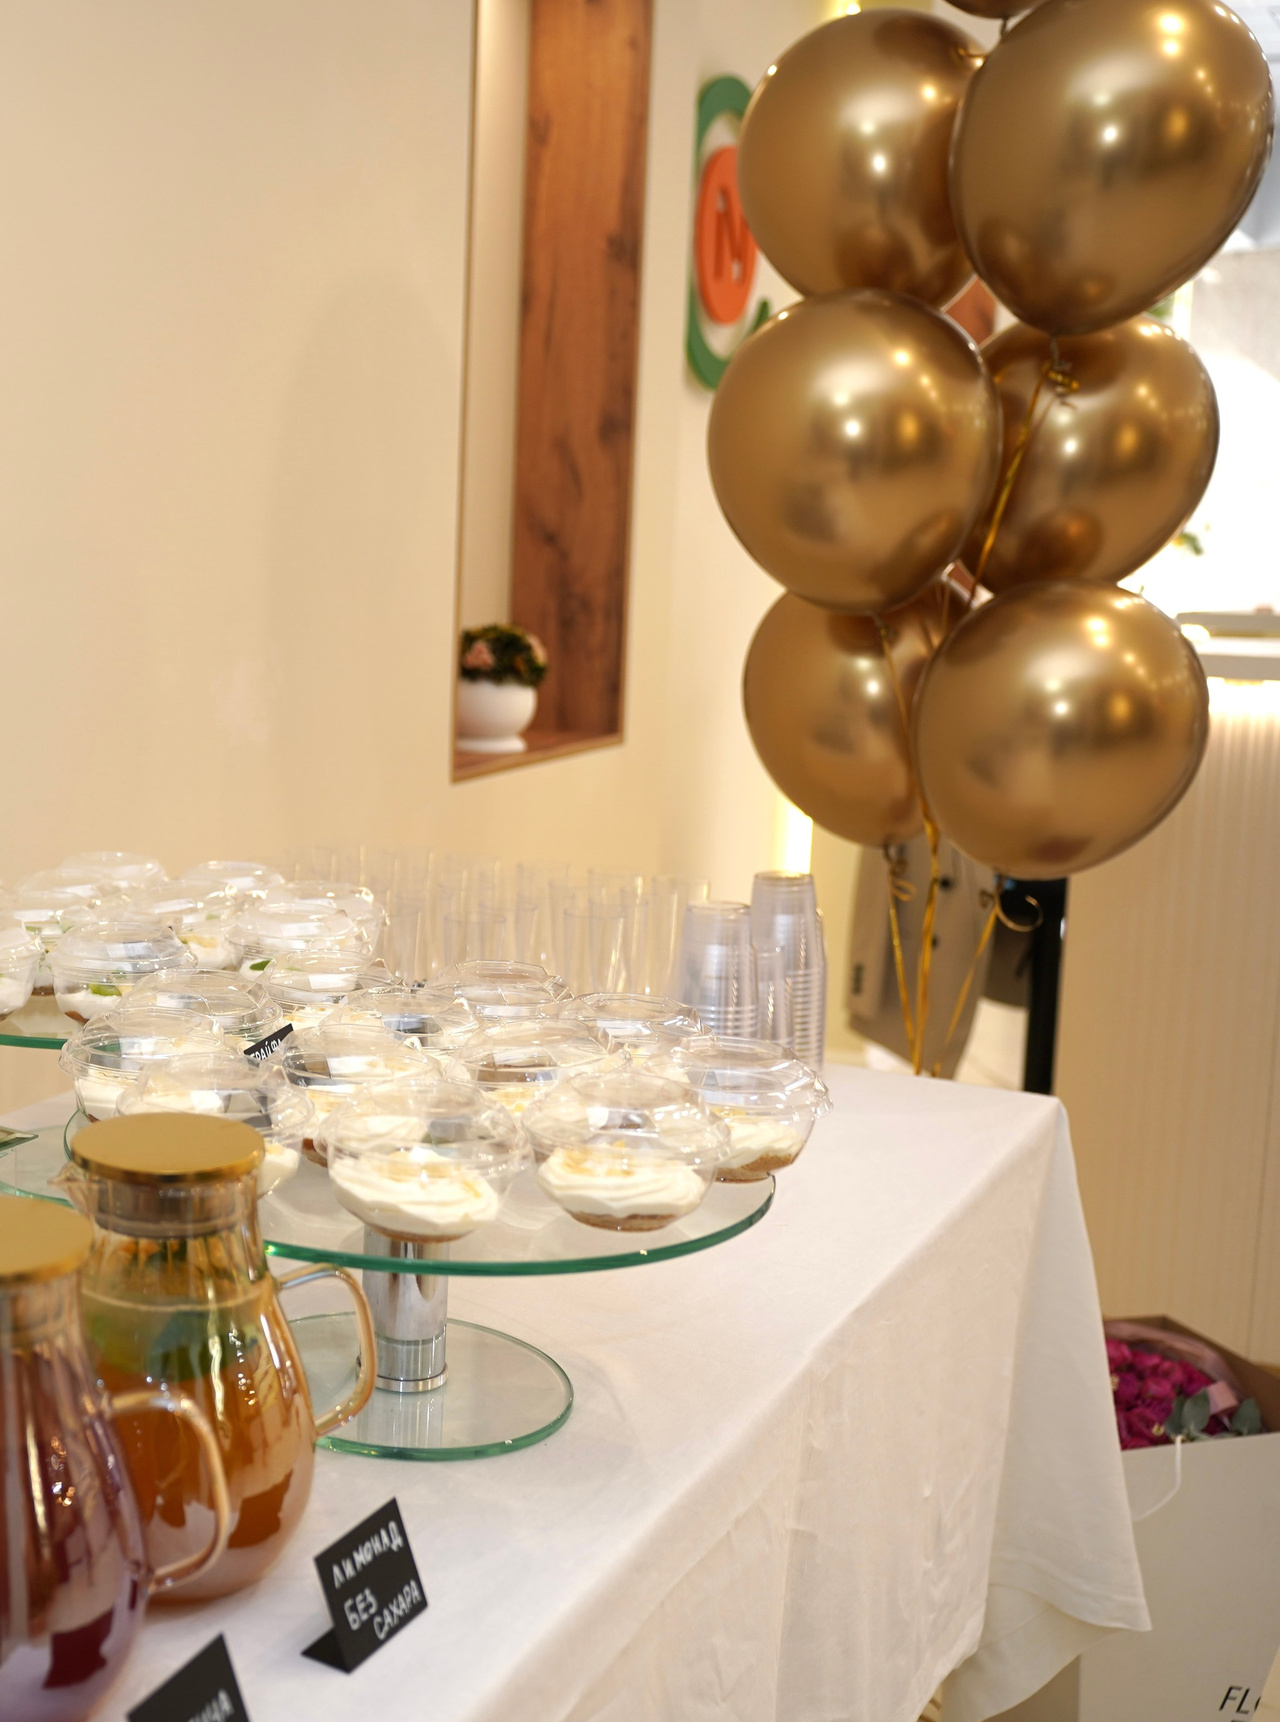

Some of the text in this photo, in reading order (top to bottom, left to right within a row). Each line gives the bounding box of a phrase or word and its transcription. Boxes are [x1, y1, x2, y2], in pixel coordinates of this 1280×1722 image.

[332, 1520, 404, 1590] ЛИМОНАД
[343, 1587, 378, 1631] БЕЗ
[373, 1579, 422, 1641] САХАРА
